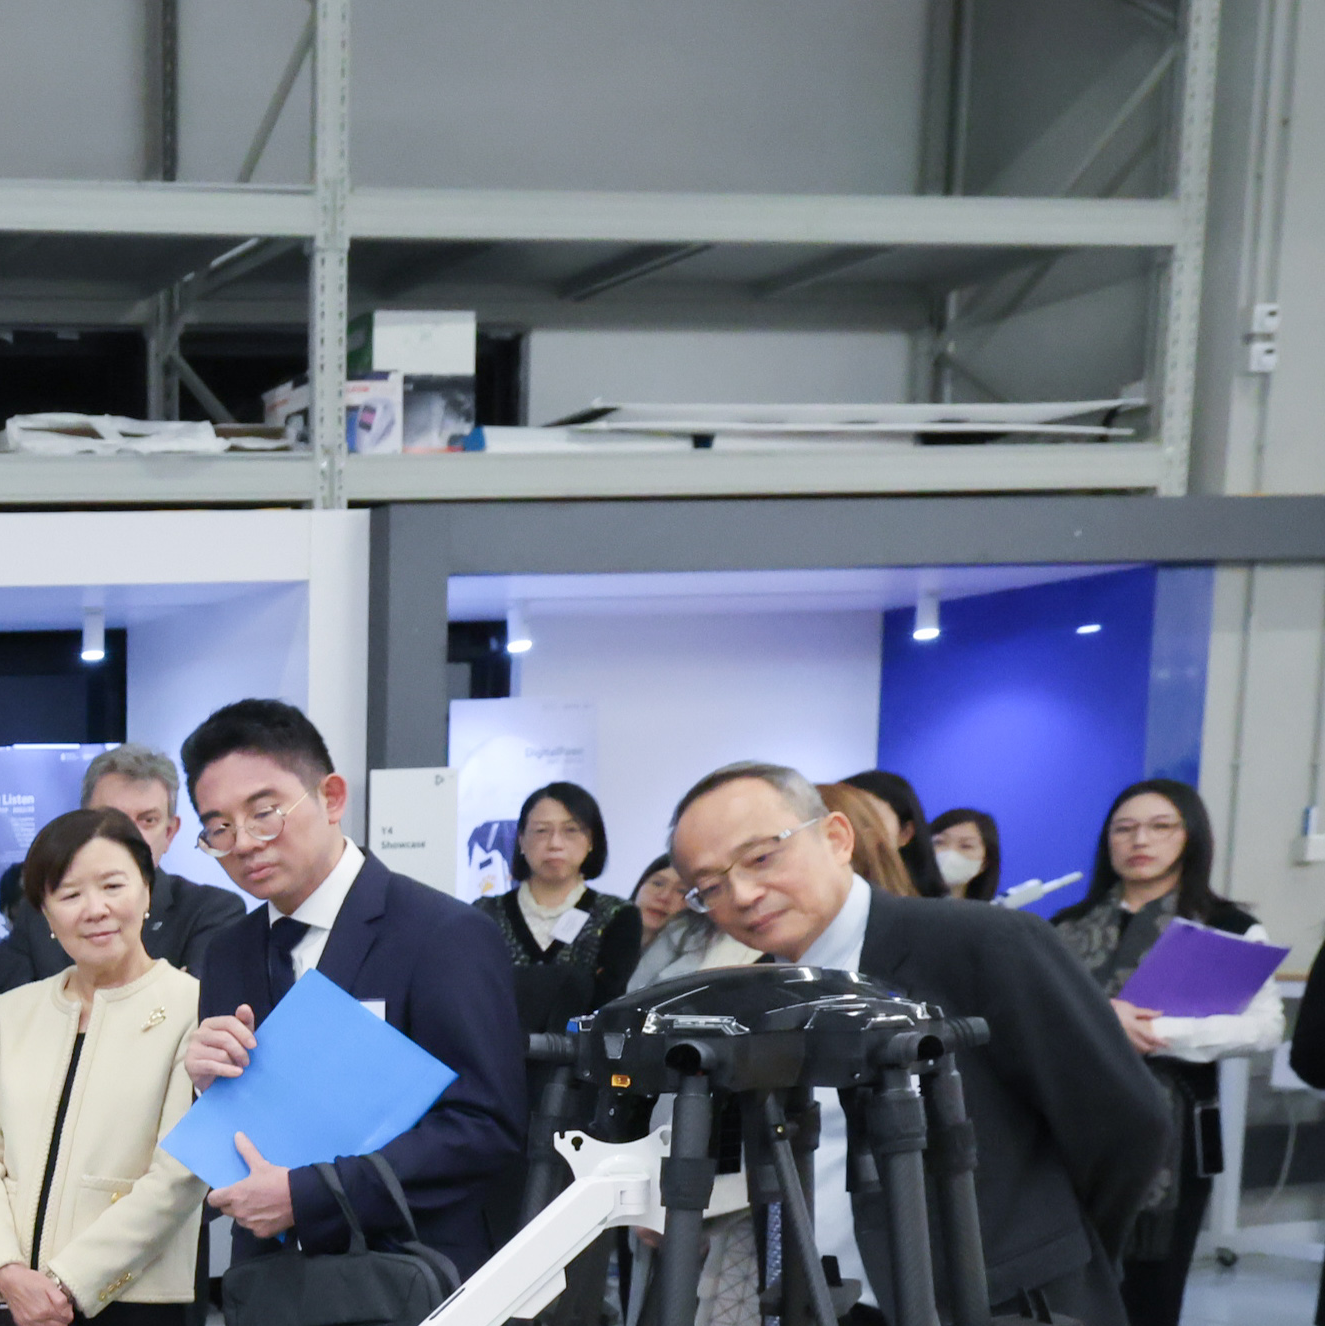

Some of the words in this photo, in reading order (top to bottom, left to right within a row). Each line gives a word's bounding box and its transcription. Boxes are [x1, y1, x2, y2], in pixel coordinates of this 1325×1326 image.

[2, 794, 35, 805] Listen
[381, 826, 394, 836] Y4
[381, 840, 426, 850] Showcase
